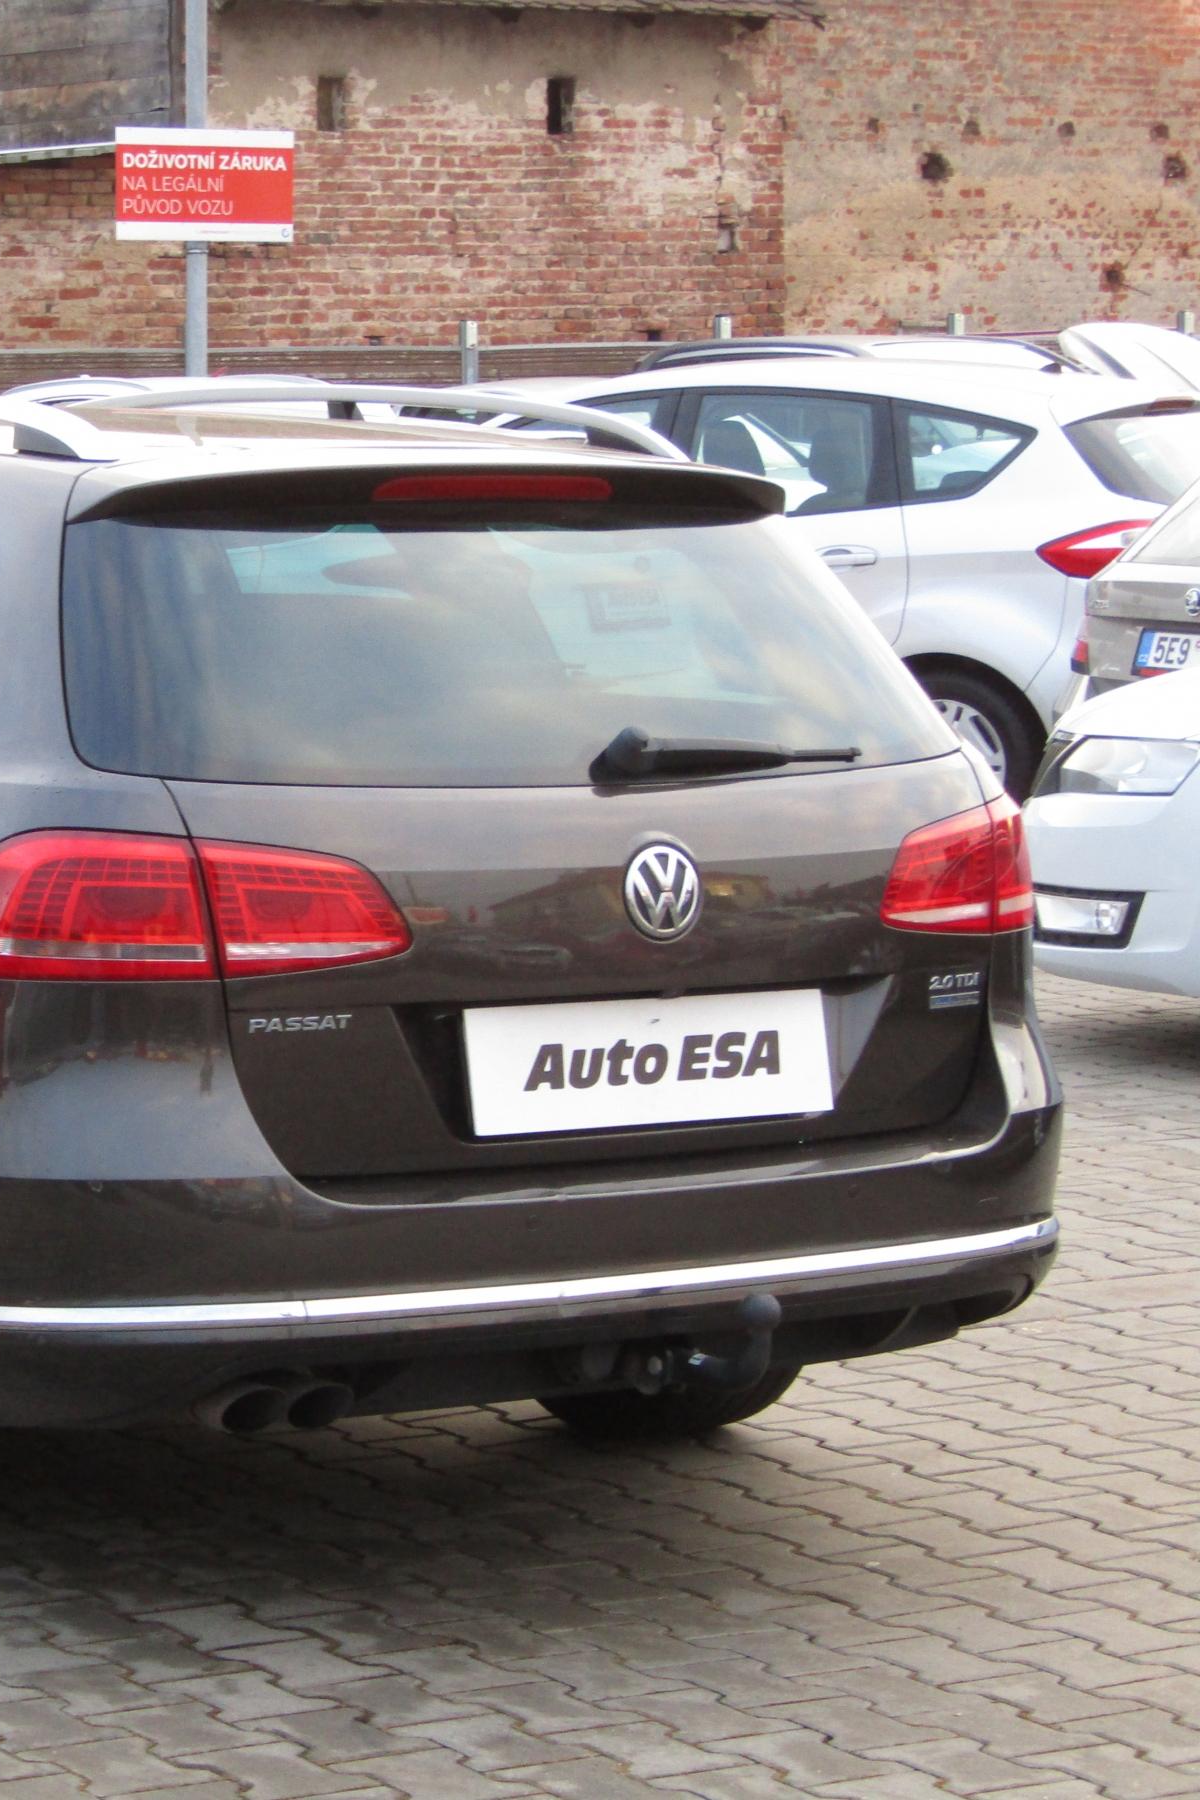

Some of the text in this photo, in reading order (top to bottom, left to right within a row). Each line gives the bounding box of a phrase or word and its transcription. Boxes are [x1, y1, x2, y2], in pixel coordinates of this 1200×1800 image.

[122, 150, 287, 171] DOŽIVOTNÍ ZÁRUKA
[122, 174, 224, 192] NA LEGÁLNÍ
[122, 194, 233, 215] PŮVOD VOZU
[1154, 636, 1191, 665] 5E9
[248, 1014, 352, 1033] PASSAT
[523, 1029, 780, 1092] Auto ESA
